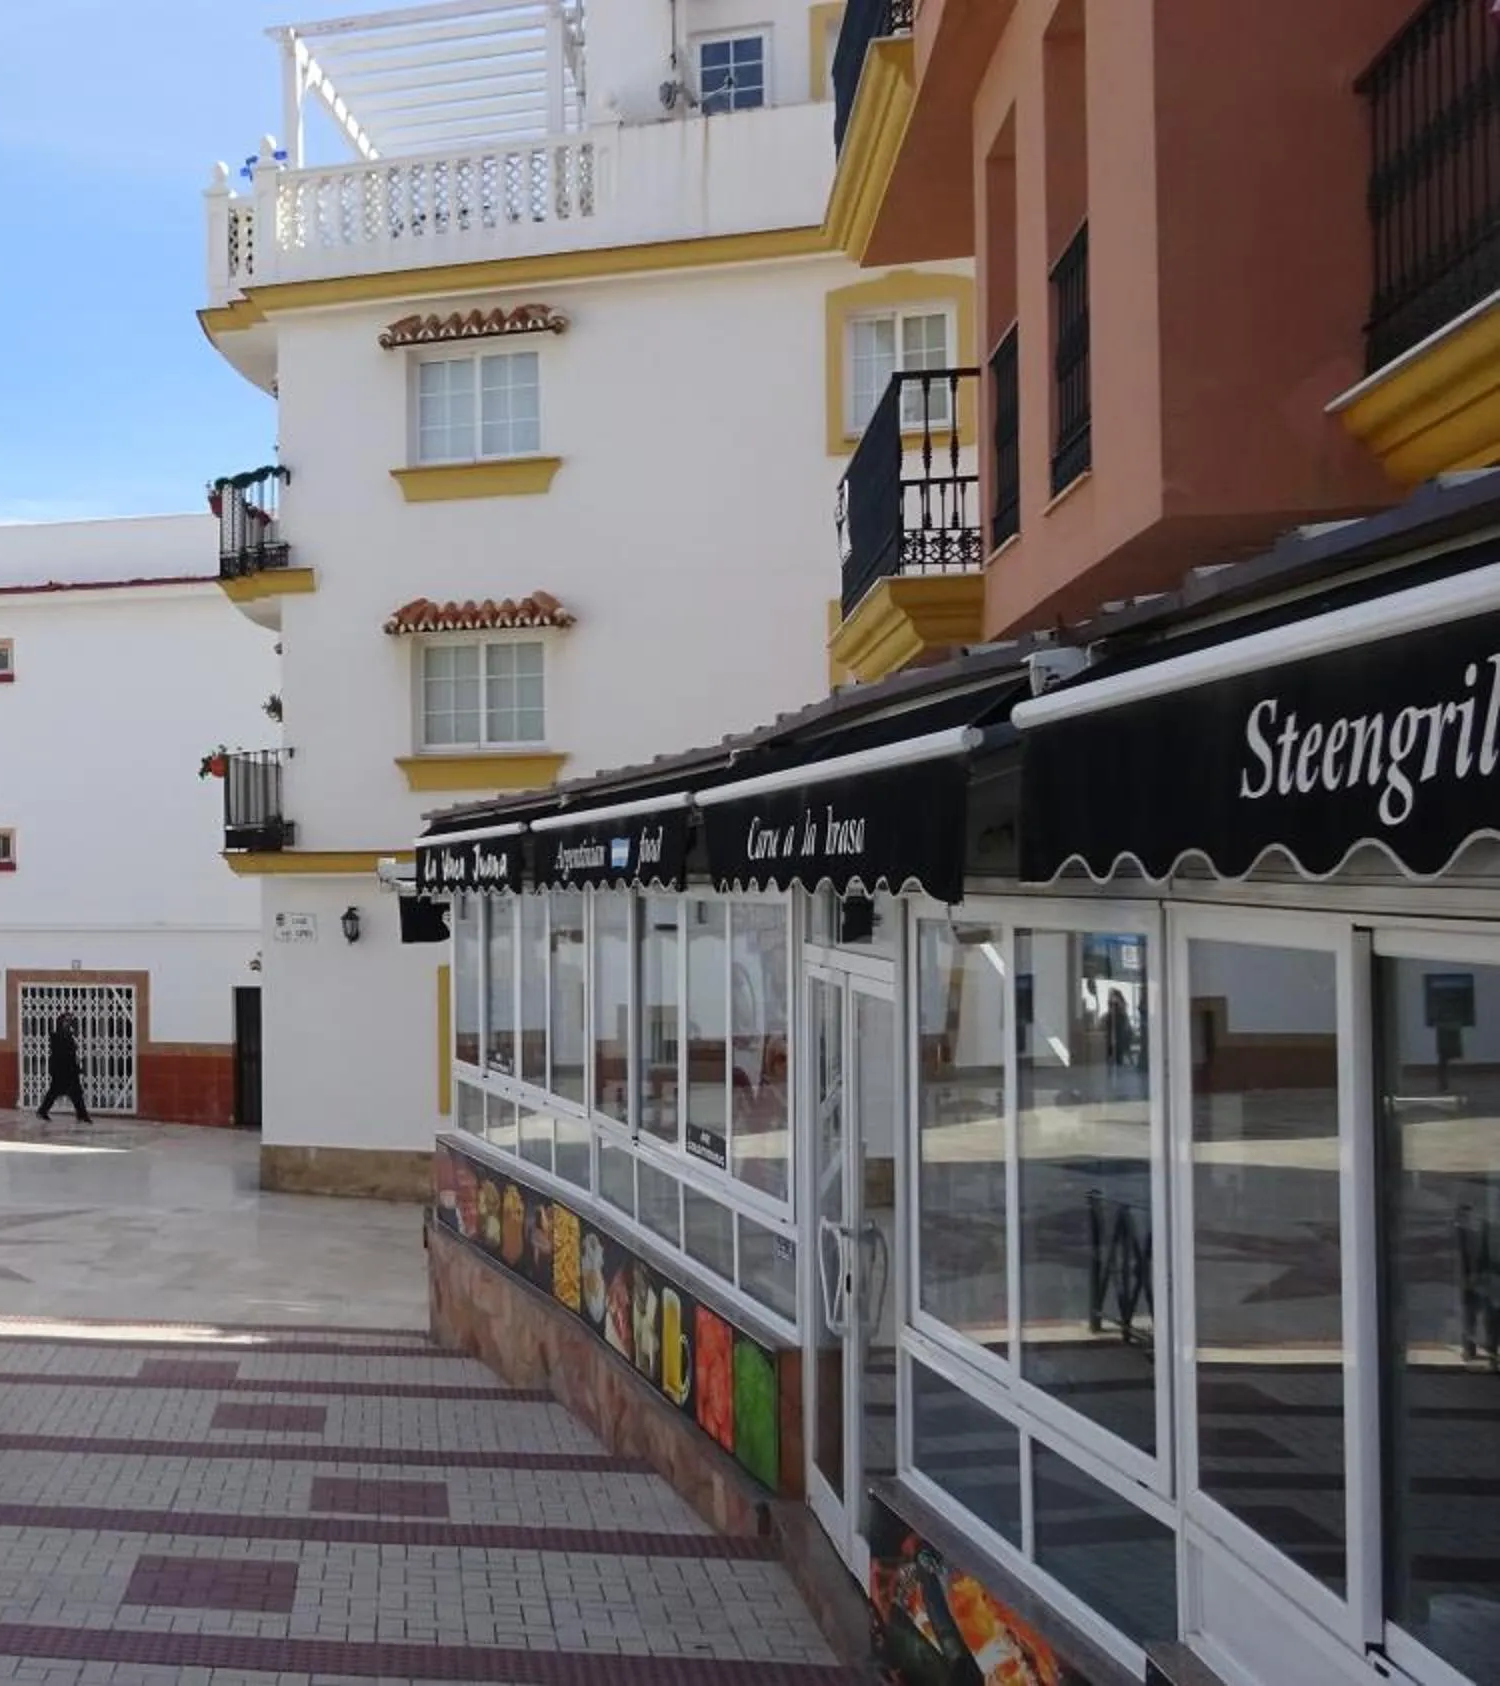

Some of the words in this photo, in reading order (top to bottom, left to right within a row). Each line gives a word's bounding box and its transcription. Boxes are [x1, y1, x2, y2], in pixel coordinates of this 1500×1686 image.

[635, 825, 663, 876] food
[783, 825, 795, 856] a
[801, 807, 817, 856] la
[825, 804, 865, 855] brasa
